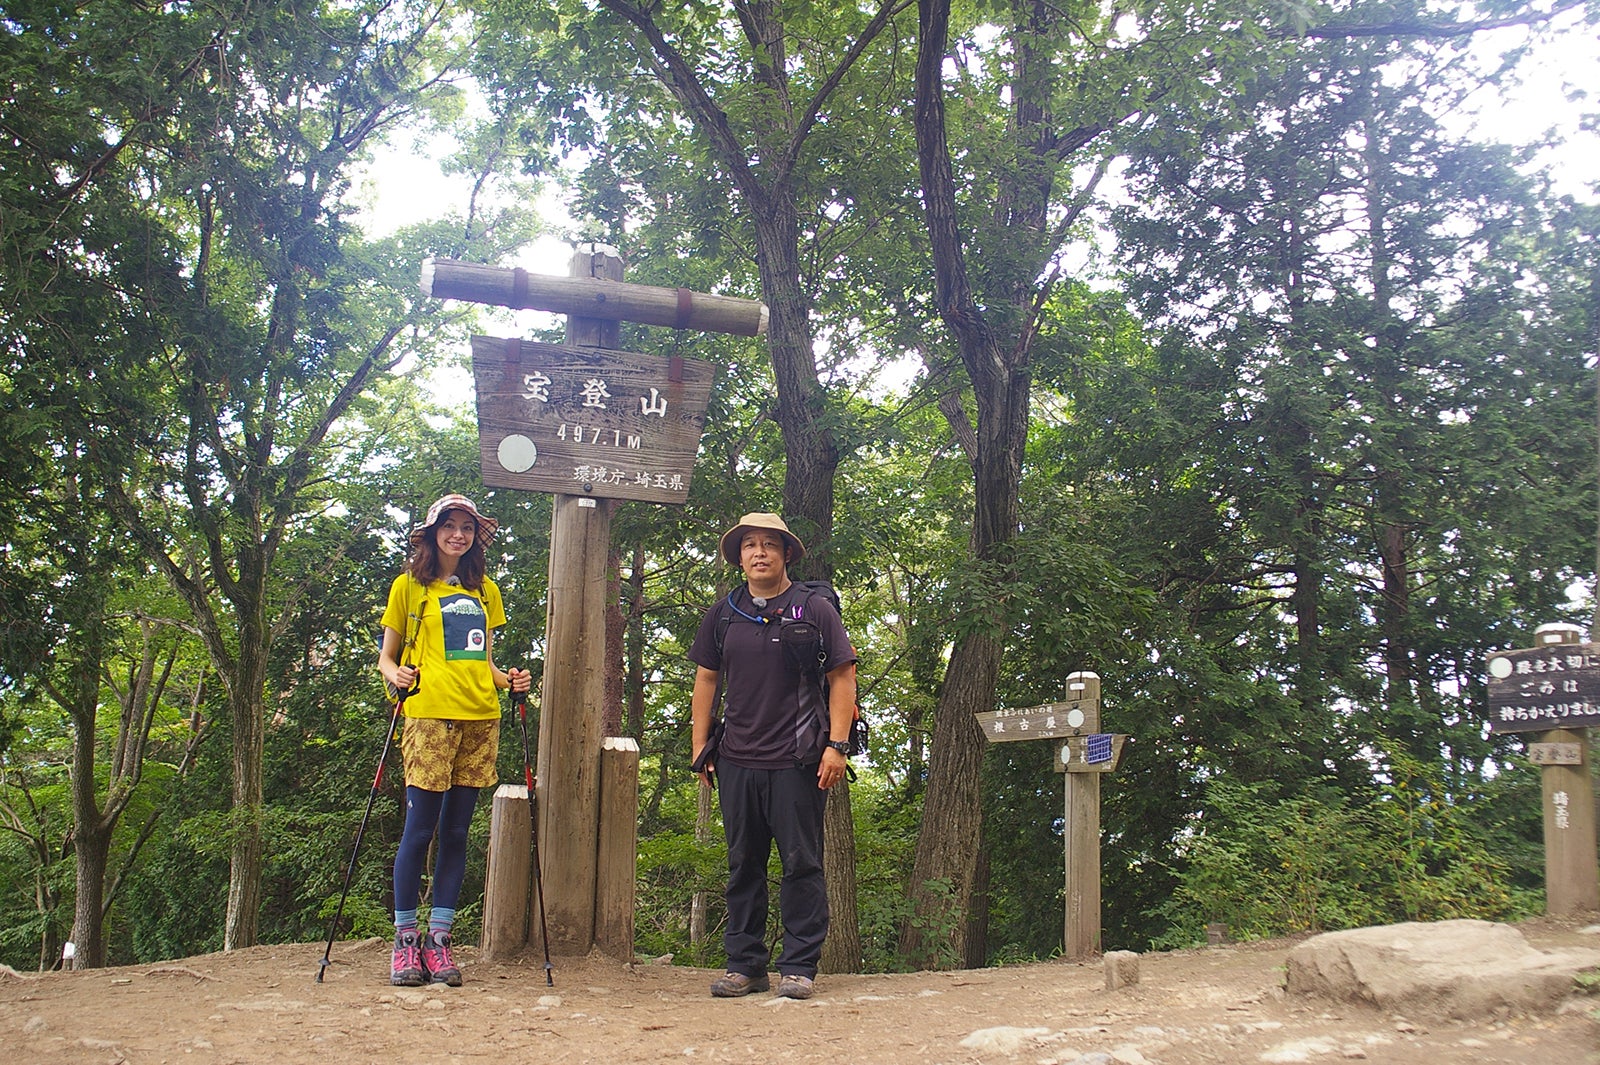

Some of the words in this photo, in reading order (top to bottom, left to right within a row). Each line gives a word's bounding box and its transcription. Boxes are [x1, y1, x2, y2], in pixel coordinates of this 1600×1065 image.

[521, 370, 669, 418] 宝登山
[556, 423, 642, 450] 497.1M
